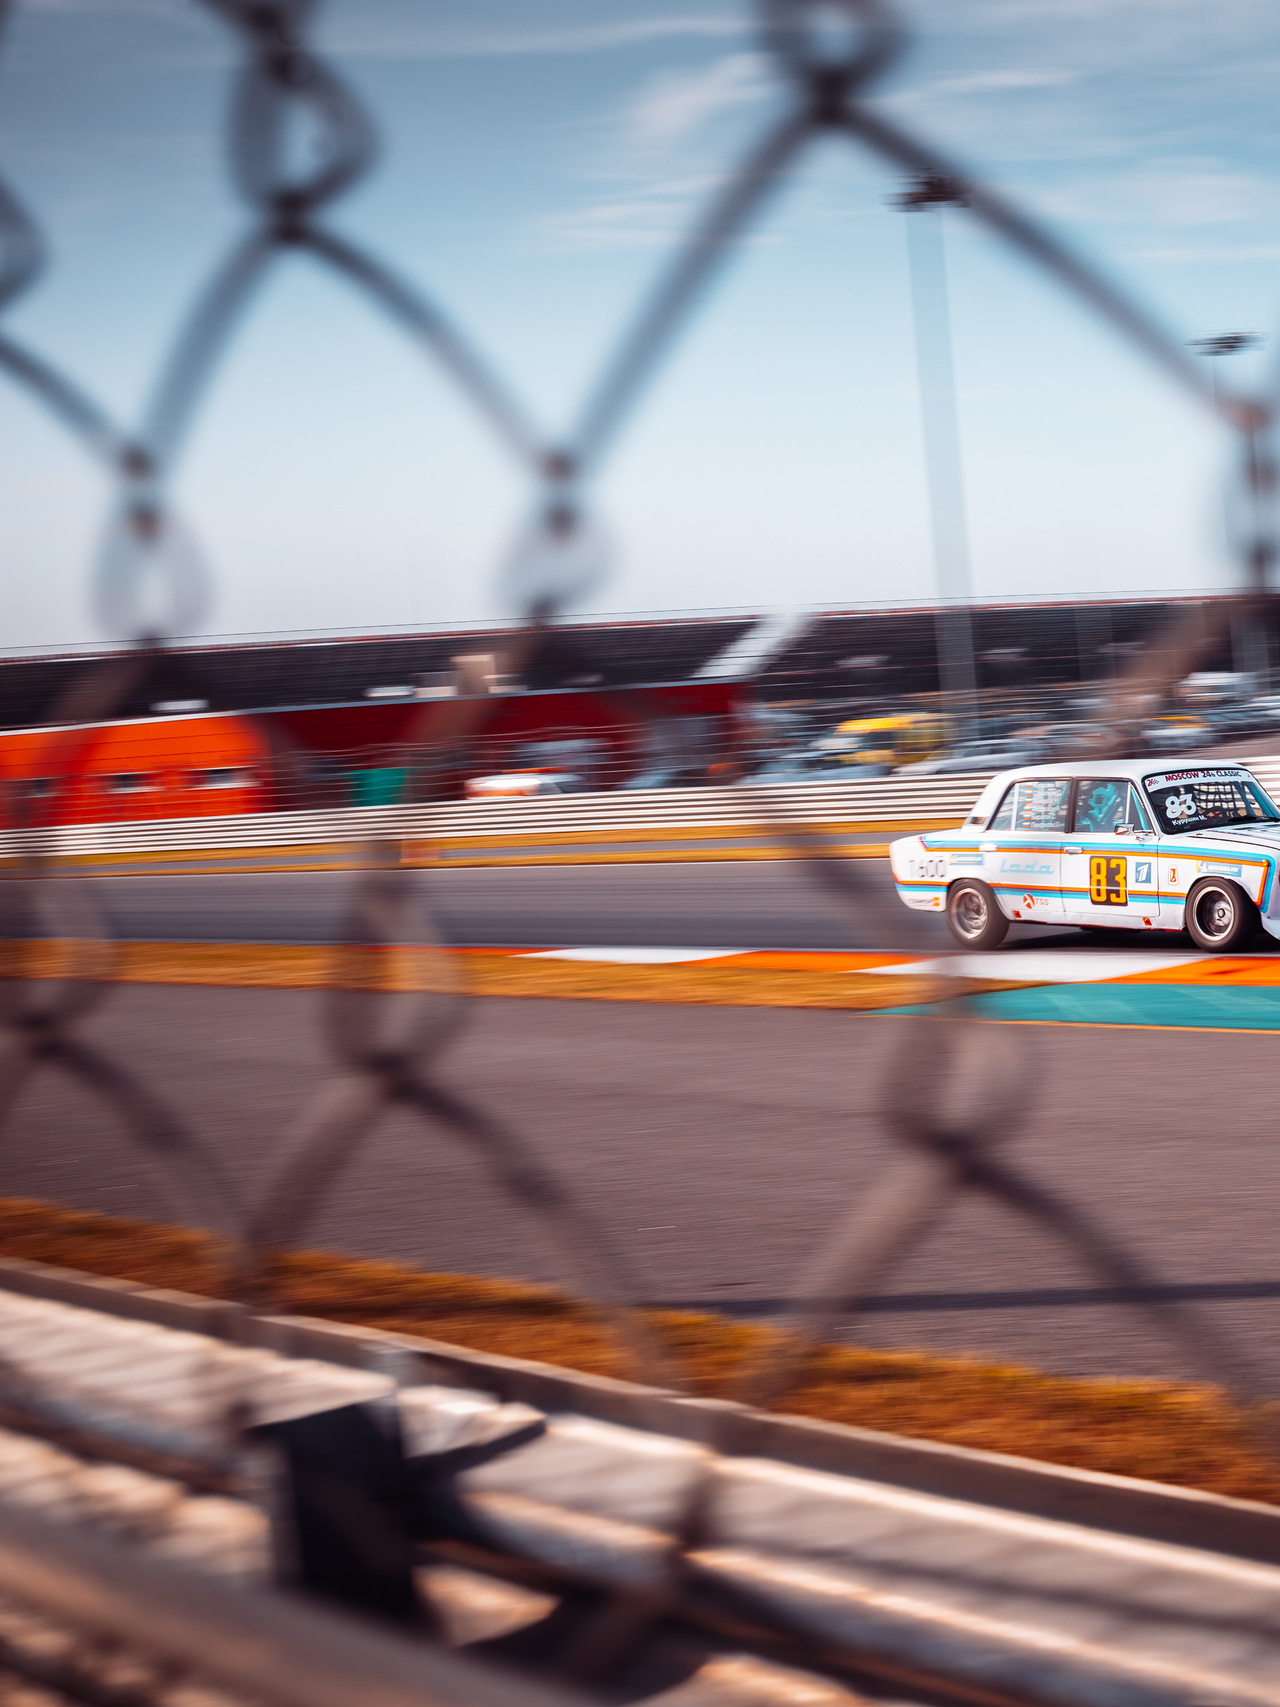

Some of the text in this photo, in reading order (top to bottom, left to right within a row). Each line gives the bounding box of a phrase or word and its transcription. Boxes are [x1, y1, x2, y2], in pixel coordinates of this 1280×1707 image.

[1165, 771, 1199, 782] MOSCOW
[1200, 770, 1216, 778] 24h
[1165, 793, 1197, 819] 83
[1000, 859, 1054, 875] Lada
[1090, 857, 1127, 903] 83
